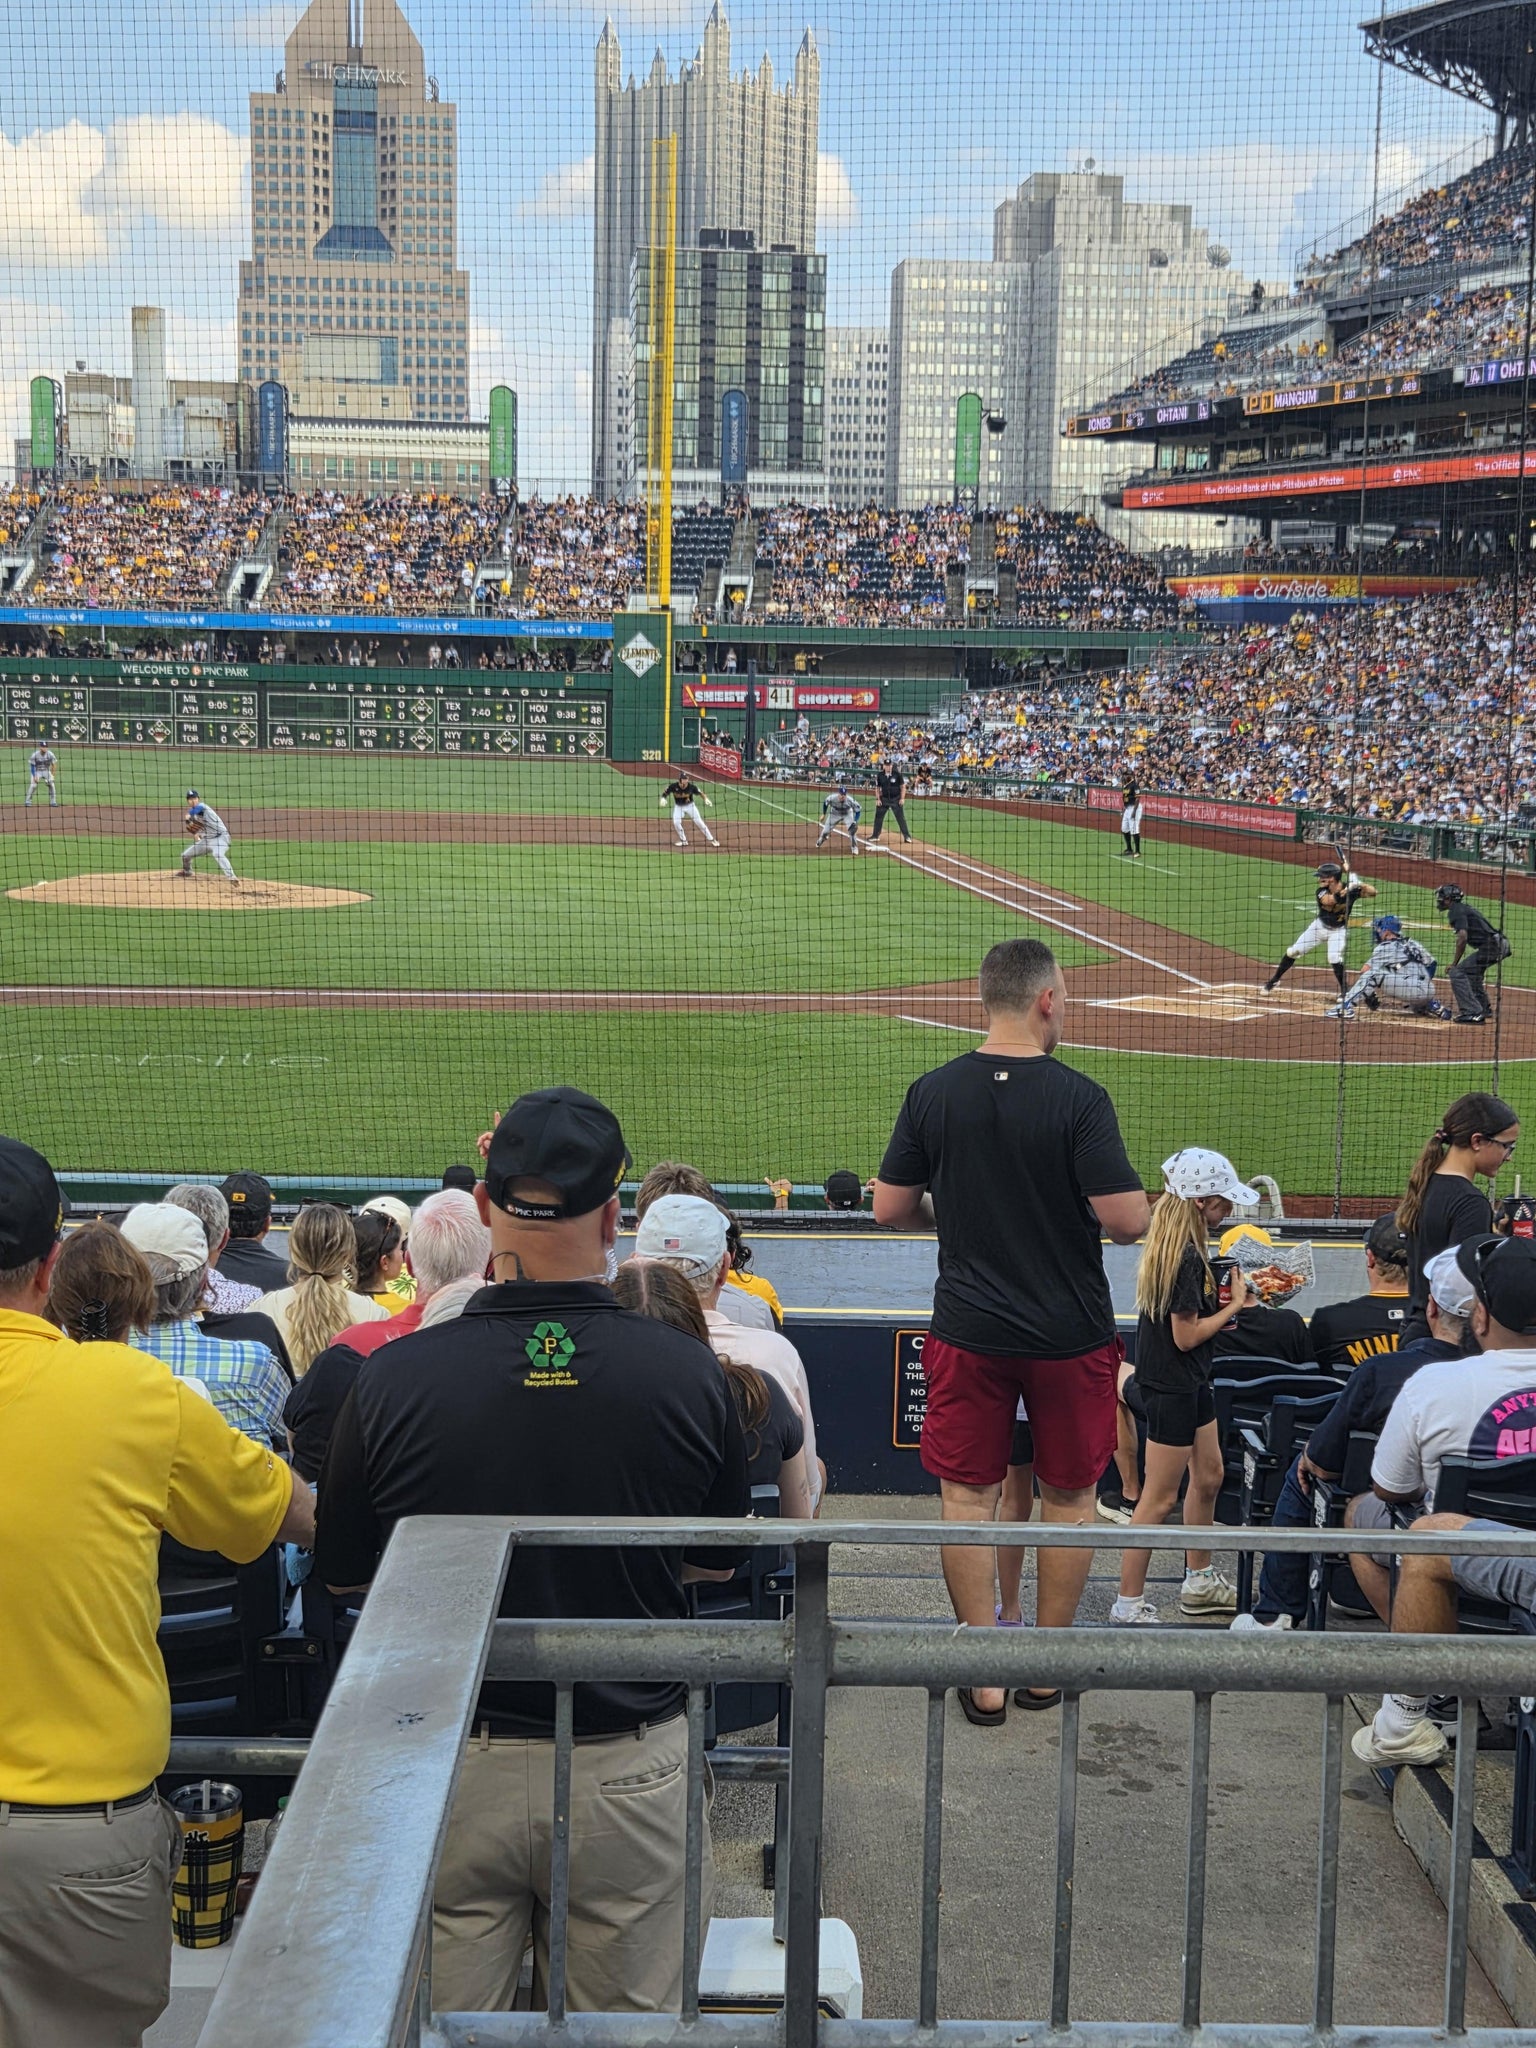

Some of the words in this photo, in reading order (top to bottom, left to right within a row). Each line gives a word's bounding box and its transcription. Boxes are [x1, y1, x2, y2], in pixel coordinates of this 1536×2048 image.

[315, 62, 406, 86] HIGHMARK
[1500, 358, 1536, 379] OHTN
[1274, 389, 1317, 408] MANGUM
[1156, 406, 1188, 423] OHTANI
[1088, 416, 1112, 431] JONES
[1491, 458, 1520, 470] Officia
[1243, 482, 1260, 493] Bank
[1254, 576, 1328, 600] Surfside
[618, 647, 662, 666] CLEMENTE
[122, 664, 174, 675] WELCOME
[176, 666, 190, 676] TO
[202, 667, 223, 676] PNC
[224, 667, 250, 677] PARK
[118, 676, 215, 688] LEAGUE
[12, 690, 31, 699] CHC
[468, 687, 566, 698] LEAGUE
[14, 701, 30, 710] COL
[73, 702, 84, 710] 24
[208, 700, 228, 710] 9:05
[360, 700, 376, 708] MIN
[445, 702, 461, 710] TEX
[529, 704, 548, 713] HOU
[182, 706, 199, 714] ATH
[472, 708, 491, 716] 7:40
[556, 710, 576, 719] 9:38
[360, 711, 376, 719] DET
[446, 713, 460, 722] KC
[530, 715, 547, 724] LAA
[52, 720, 58, 728] 4
[100, 720, 112, 730] AZ
[136, 722, 143, 731] 0
[52, 730, 58, 739] 5
[276, 726, 291, 735] ATL
[360, 728, 378, 737] BOS
[98, 732, 116, 740] MIA
[136, 732, 144, 742] 0
[182, 735, 199, 743] TOR
[444, 731, 462, 740] NYY
[530, 733, 547, 742] SEA
[568, 734, 576, 743] 0
[272, 737, 294, 746] CWS
[362, 740, 374, 748] TB
[446, 742, 461, 750] CLE
[530, 744, 546, 753] BAL
[568, 746, 576, 754] 0
[642, 749, 662, 761] 320
[514, 1207, 532, 1217] PNC
[524, 1378, 554, 1388] Recycled
[555, 1378, 579, 1386] Bottles
